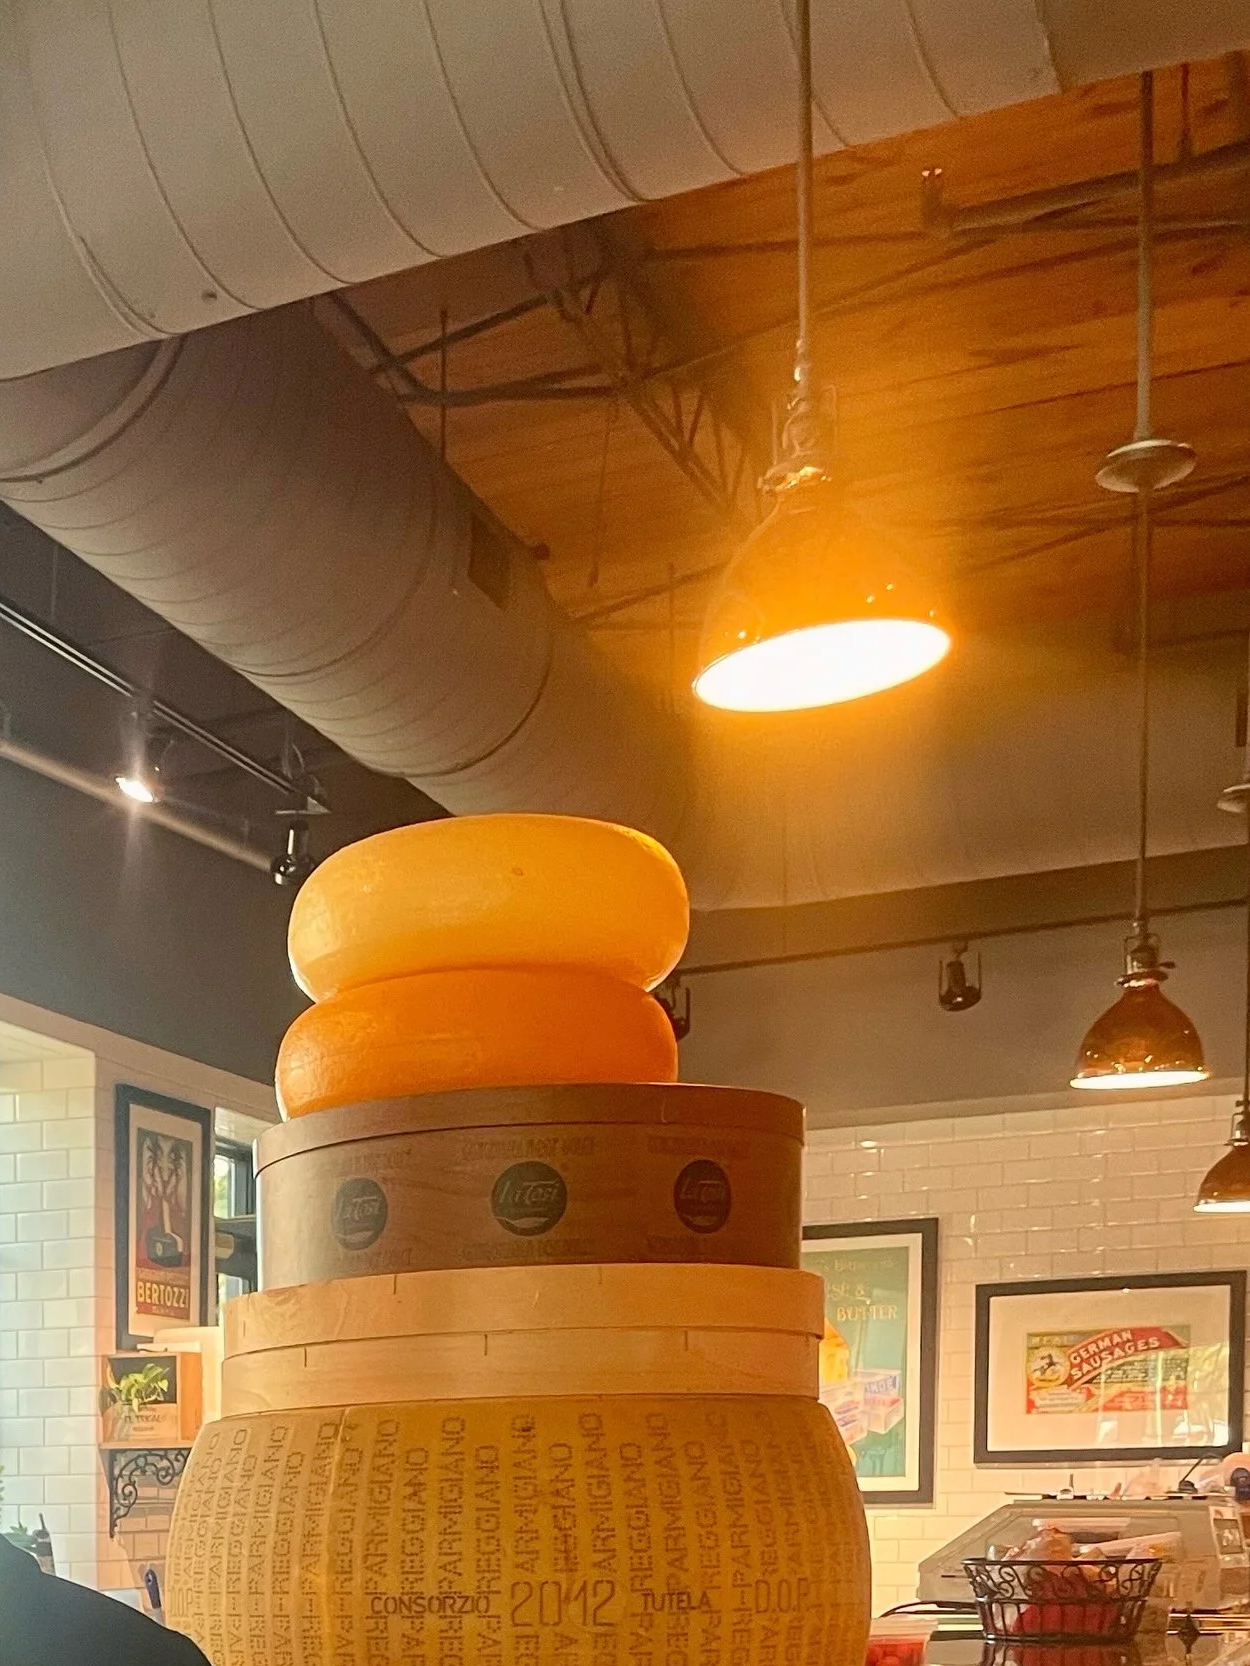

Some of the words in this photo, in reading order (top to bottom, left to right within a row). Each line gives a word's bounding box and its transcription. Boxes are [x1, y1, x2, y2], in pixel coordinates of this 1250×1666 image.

[137, 1281, 189, 1309] BERTOZZI
[837, 1305, 898, 1322] BUTTER
[1070, 1330, 1133, 1364] GERMAN
[1070, 1337, 1160, 1380] SAUSAGES
[370, 1595, 491, 1615] CONSORZIO
[510, 1579, 617, 1627] 2012
[642, 1590, 712, 1612] TUTELA
